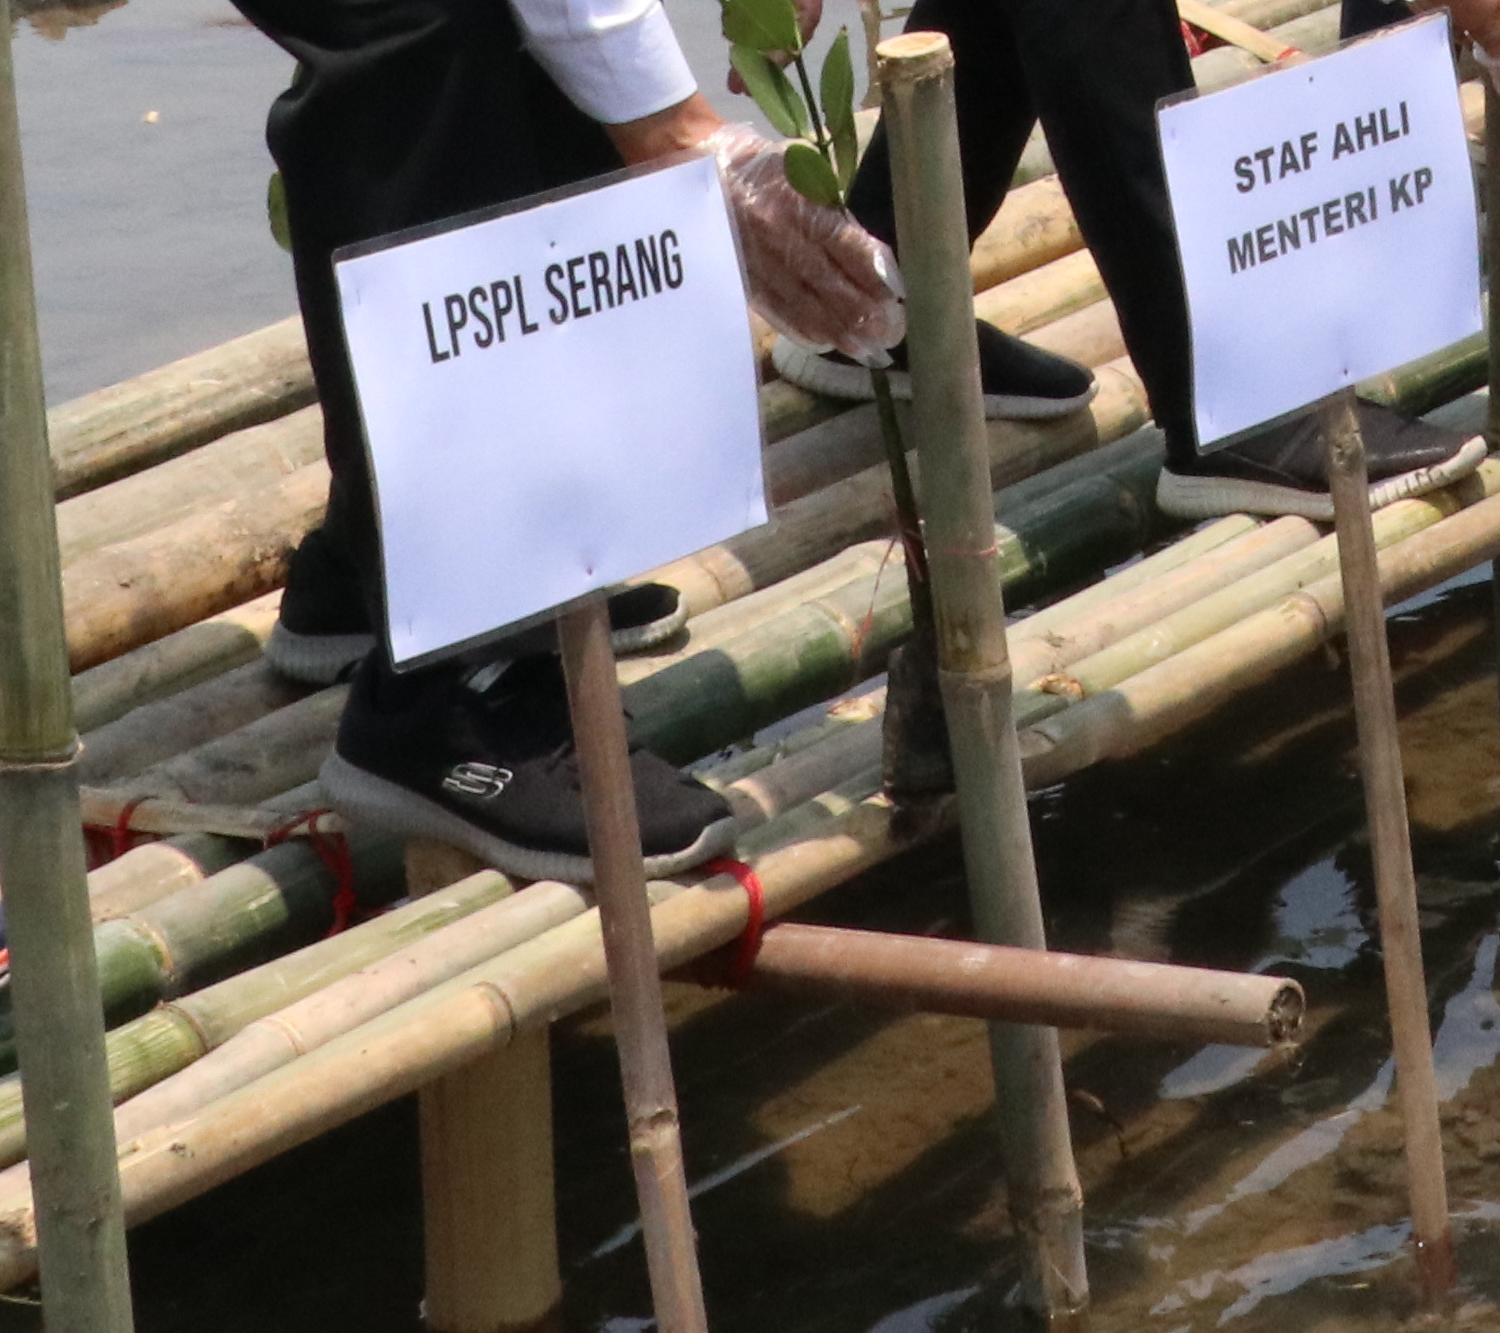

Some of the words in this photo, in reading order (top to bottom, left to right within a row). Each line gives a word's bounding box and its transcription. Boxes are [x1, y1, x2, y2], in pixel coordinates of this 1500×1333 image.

[1234, 131, 1318, 193] STAF
[1332, 101, 1410, 160] AHLI
[1227, 187, 1377, 274] MENTERI
[1389, 167, 1433, 213] KP
[422, 274, 539, 364] LPSPL
[545, 229, 684, 325] SERANG
